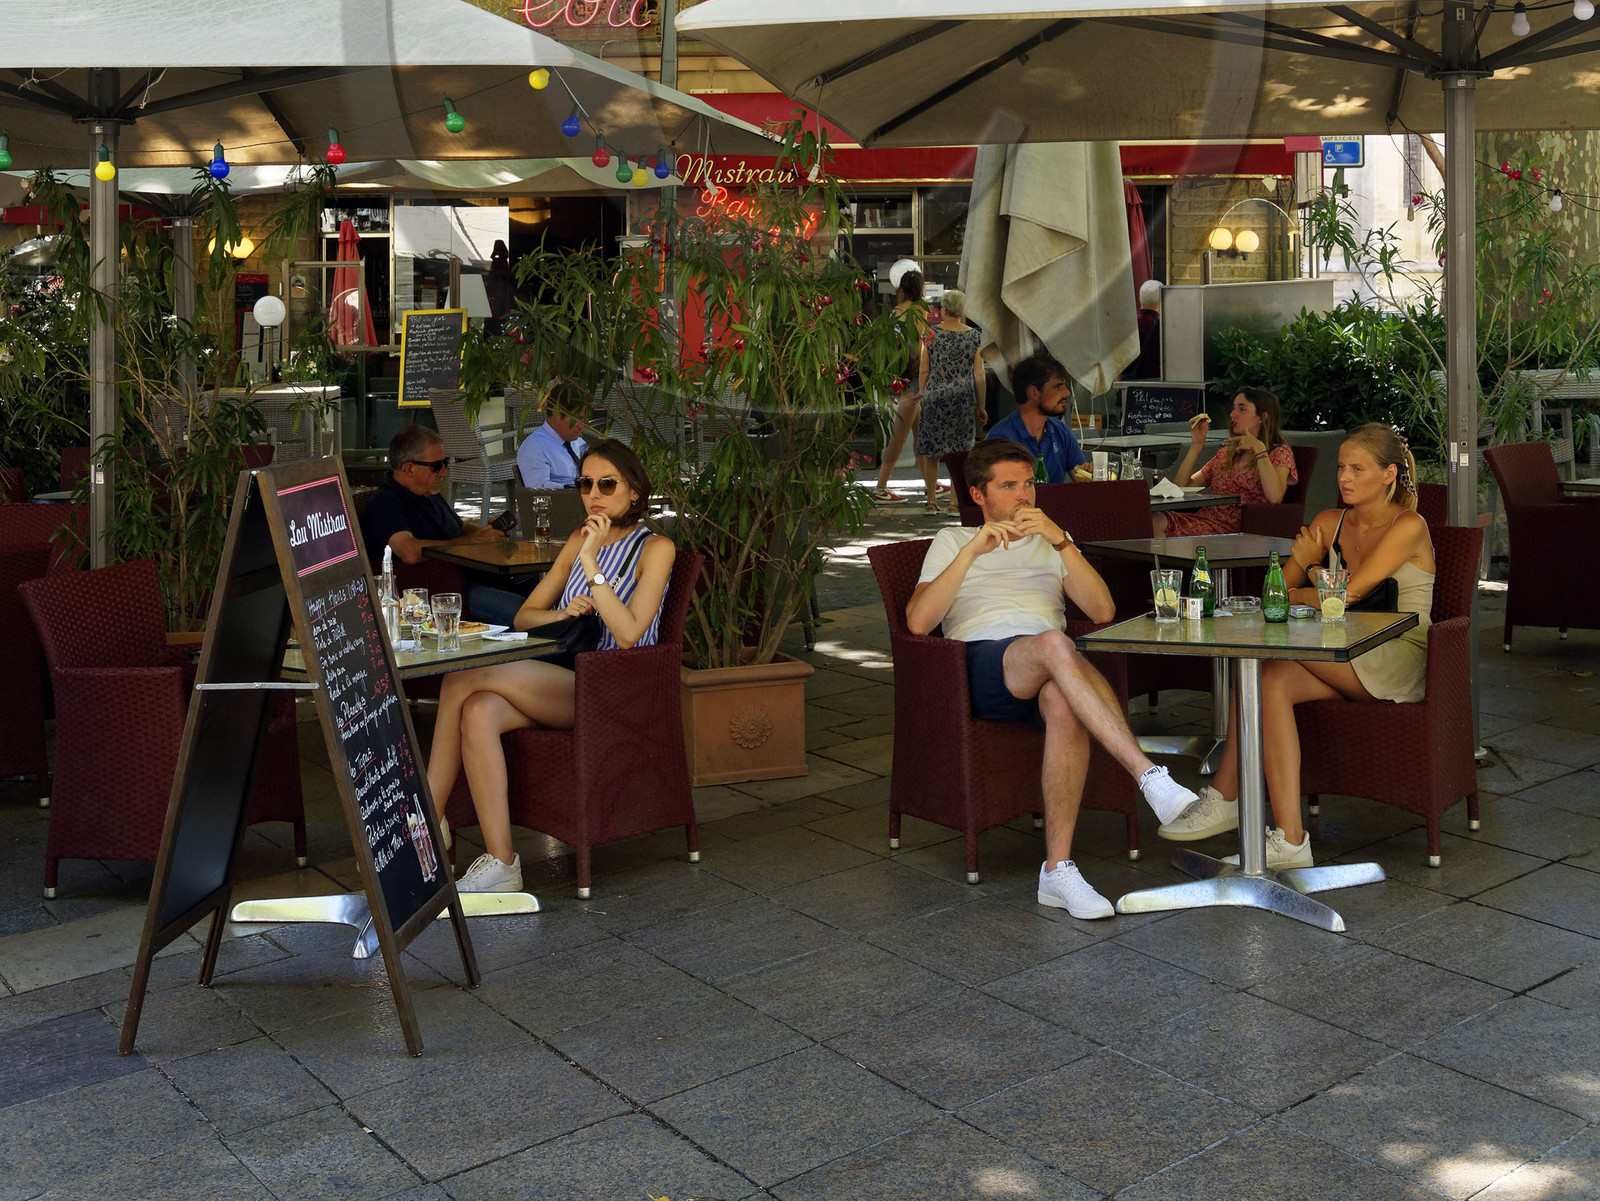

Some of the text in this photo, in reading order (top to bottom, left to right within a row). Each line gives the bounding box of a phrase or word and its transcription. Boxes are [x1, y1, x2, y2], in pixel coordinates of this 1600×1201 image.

[289, 511, 347, 547] Lou Mistrau
[306, 598, 327, 620] Happy
